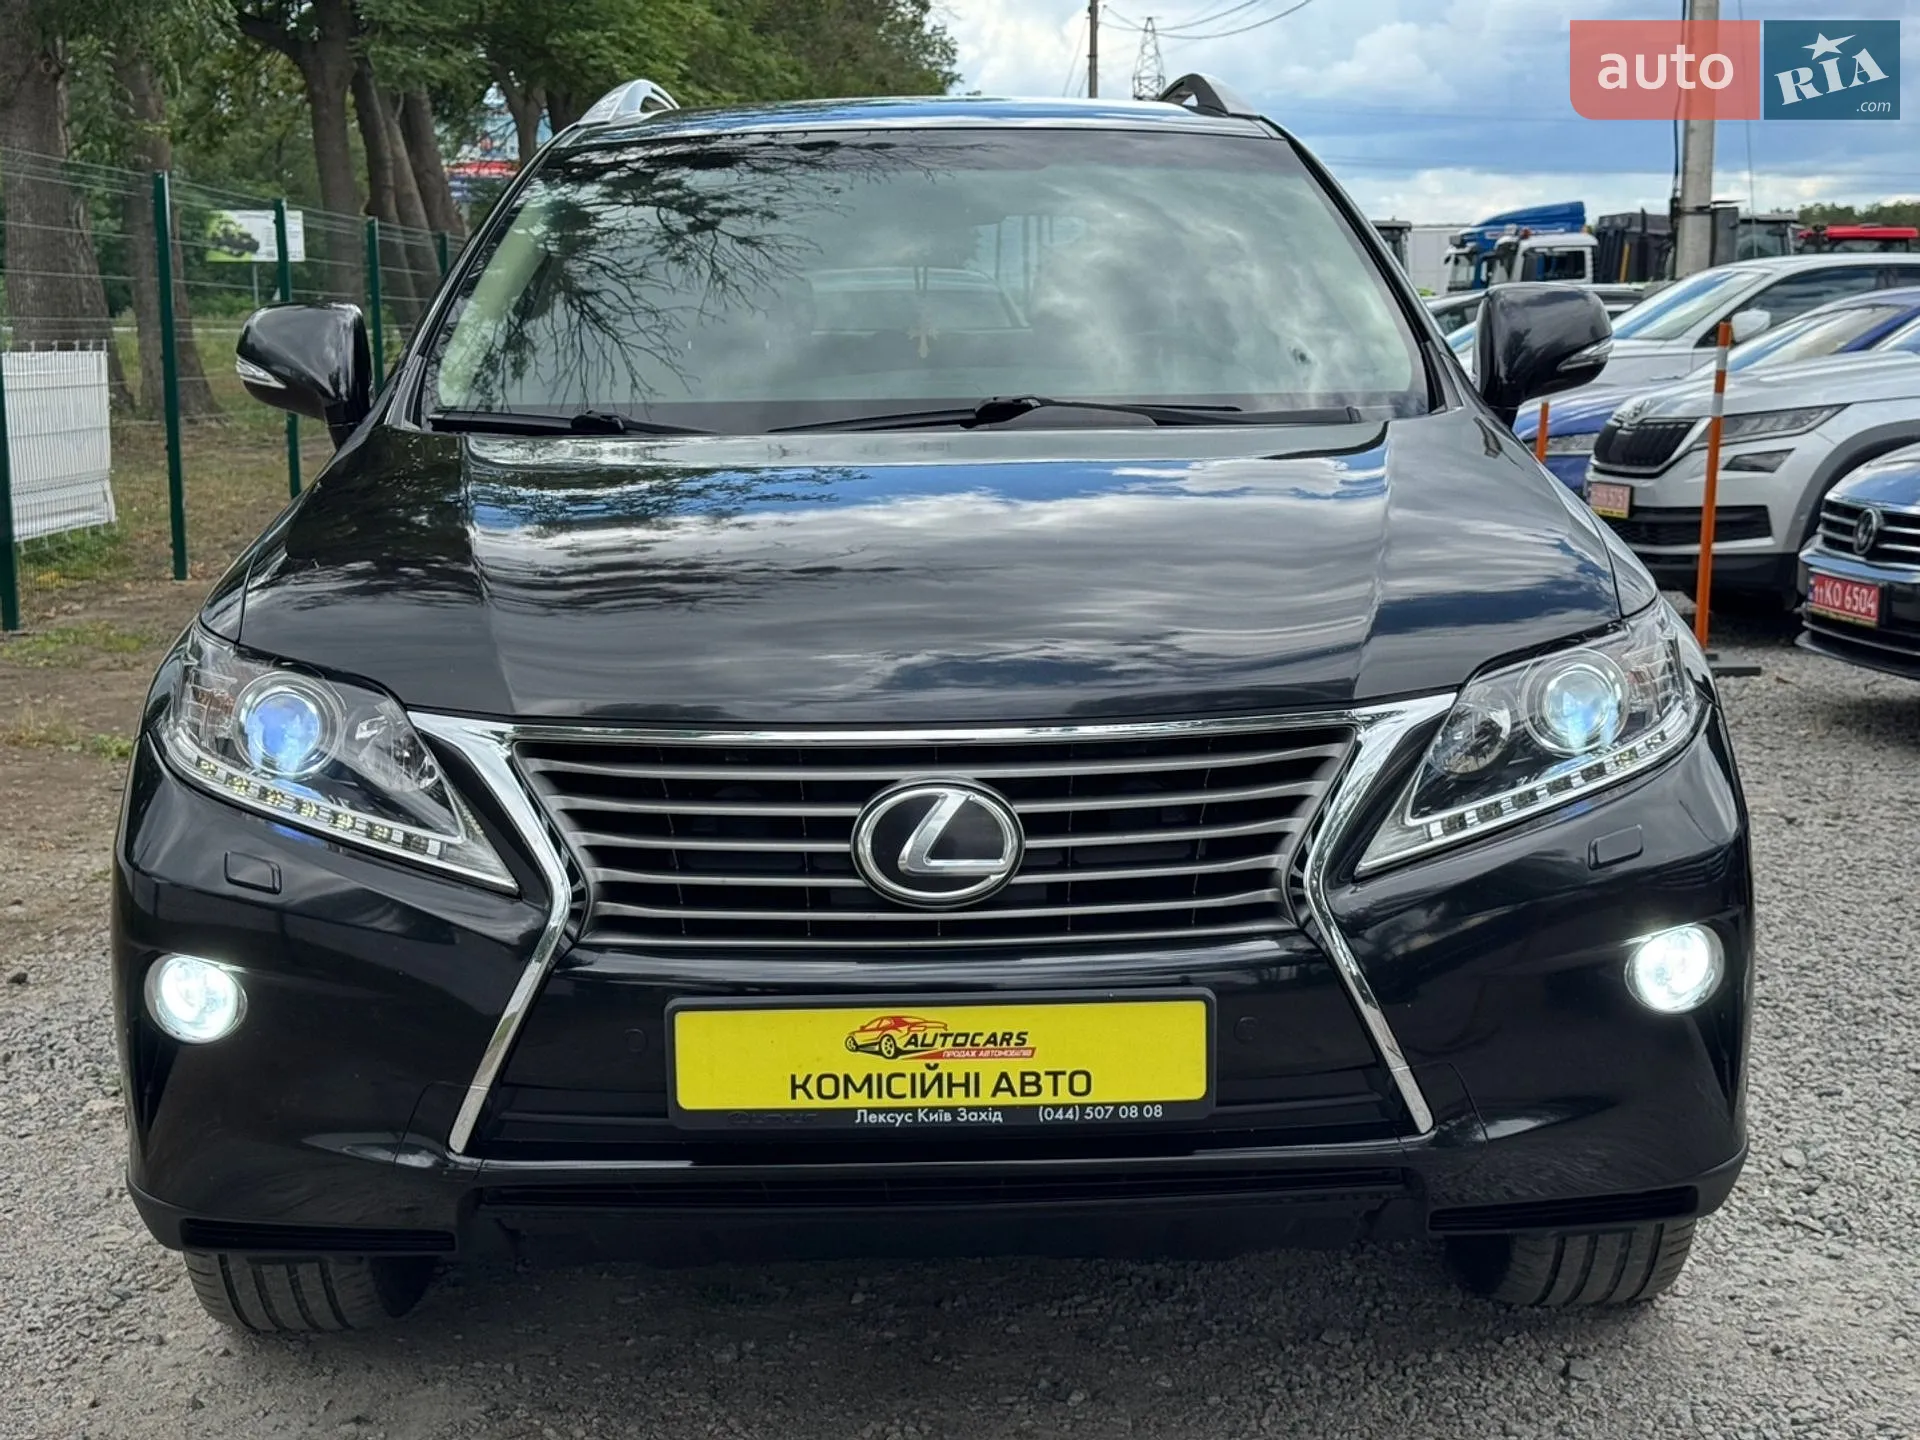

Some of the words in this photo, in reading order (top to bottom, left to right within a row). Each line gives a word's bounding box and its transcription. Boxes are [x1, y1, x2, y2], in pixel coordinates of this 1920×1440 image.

[1844, 583, 1877, 616] 6504
[904, 1031, 1029, 1048] AUTOCARS
[790, 1063, 980, 1100] КОМІСІЙНІ
[991, 1070, 1092, 1098] АВТО
[855, 1109, 913, 1126] Лексус
[917, 1108, 951, 1122] Київ
[956, 1107, 1003, 1122] Захід
[1039, 1105, 1079, 1122] (044)
[1084, 1106, 1115, 1120] 507
[1118, 1105, 1139, 1118] 08
[1142, 1104, 1163, 1118] 08
